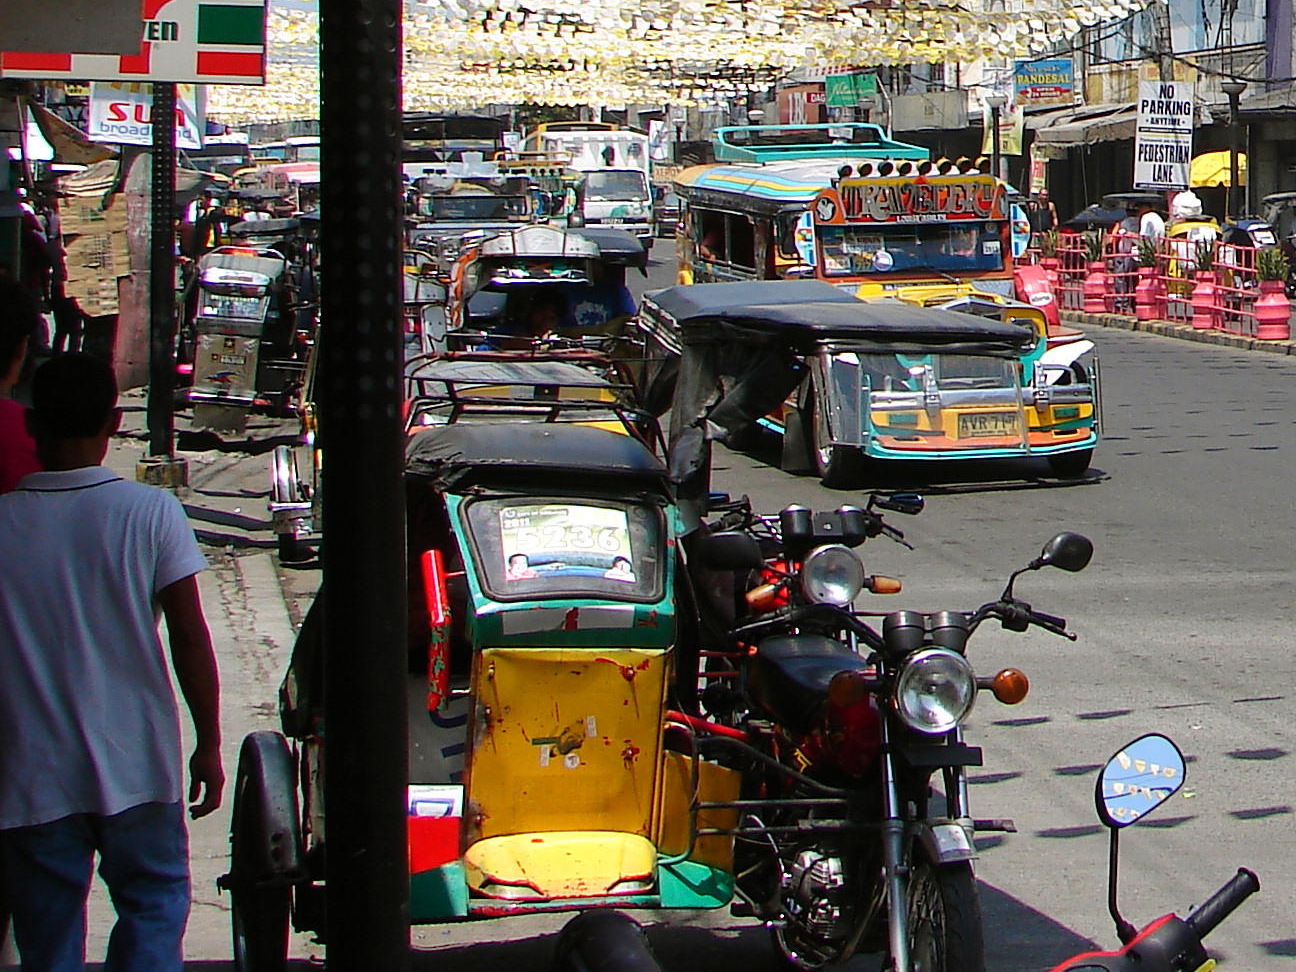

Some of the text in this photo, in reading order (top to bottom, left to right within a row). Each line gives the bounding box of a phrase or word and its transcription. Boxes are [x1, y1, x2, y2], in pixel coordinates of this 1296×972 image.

[1016, 73, 1071, 85] PANDESAL
[1159, 84, 1175, 99] NO
[1141, 99, 1191, 116] PARKING
[99, 121, 192, 139] broadnd
[1138, 143, 1190, 164] PEDESTRIAN
[1152, 164, 1174, 183] LANE
[961, 415, 988, 431] AVR
[503, 517, 530, 529] 2011
[515, 524, 622, 551] 5236
